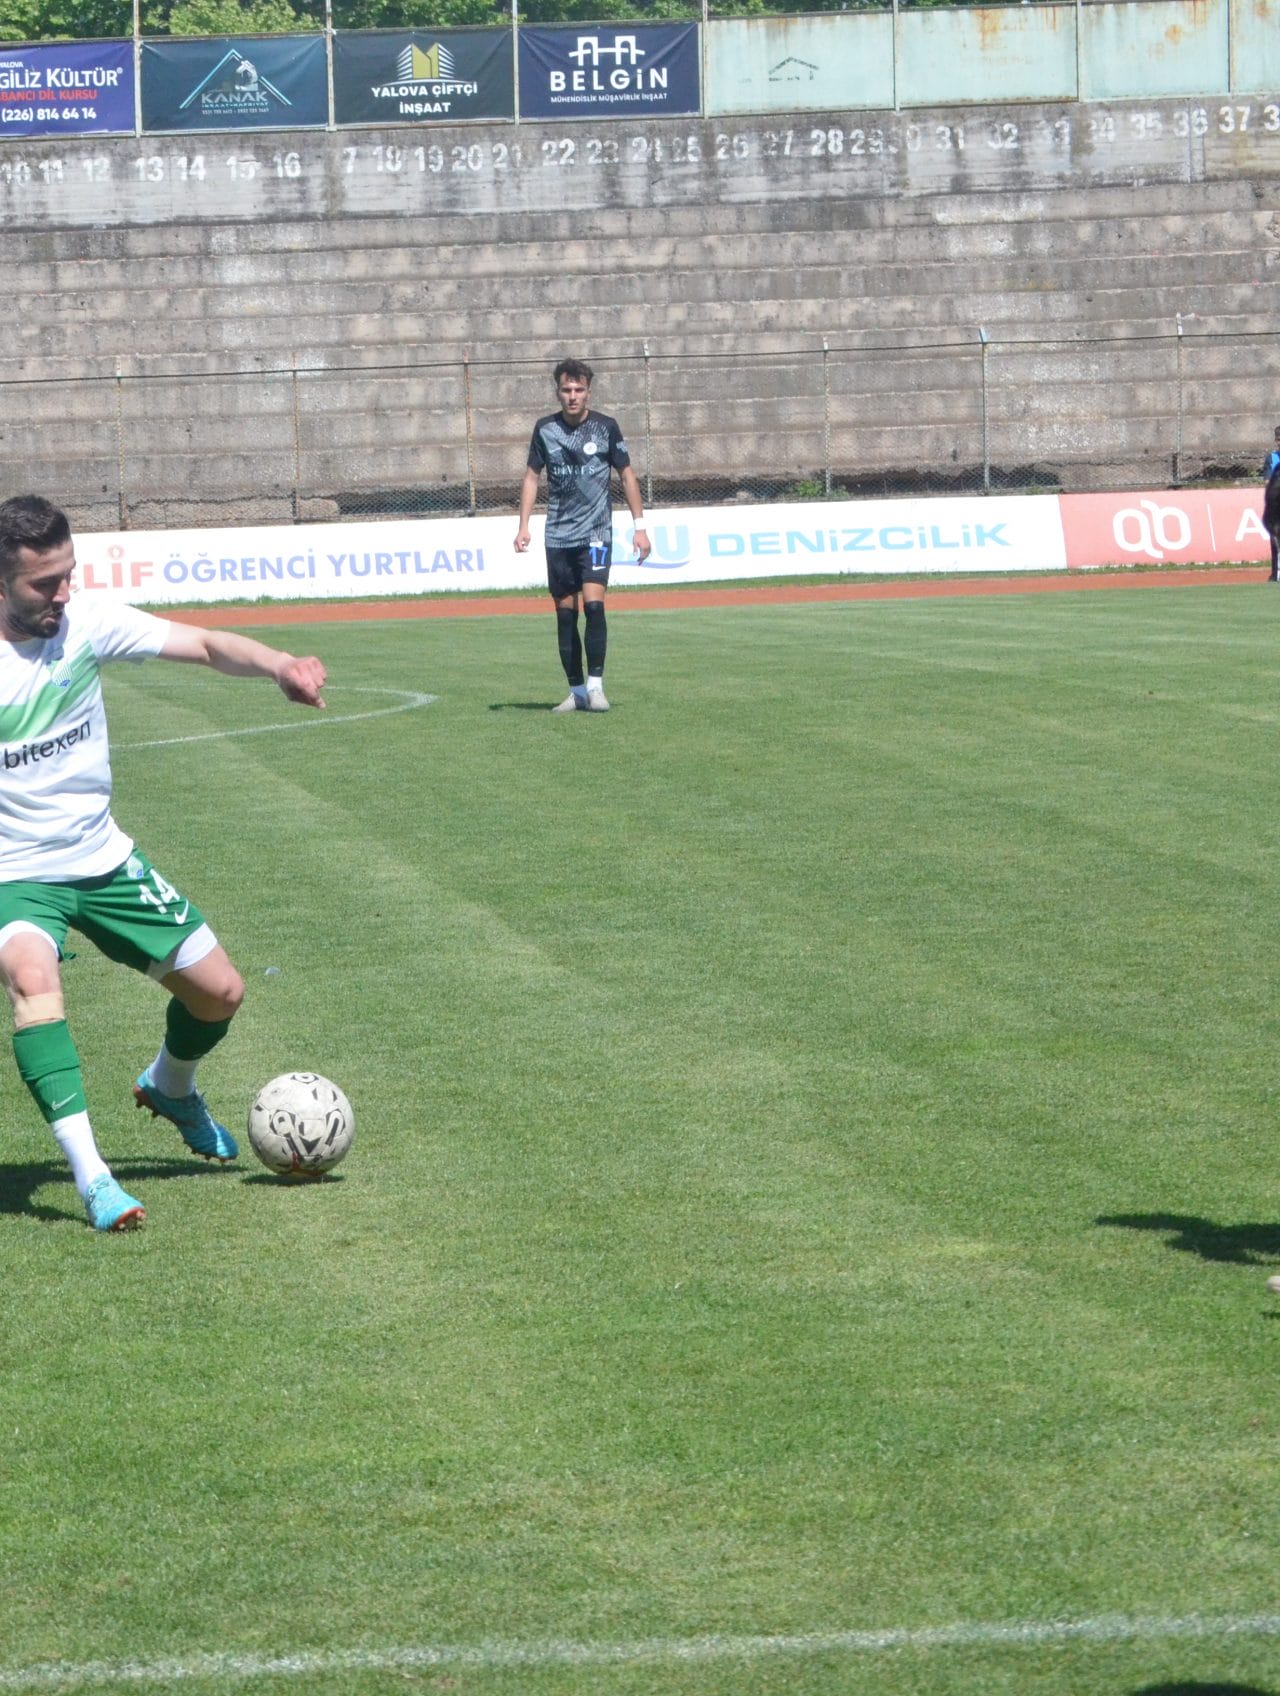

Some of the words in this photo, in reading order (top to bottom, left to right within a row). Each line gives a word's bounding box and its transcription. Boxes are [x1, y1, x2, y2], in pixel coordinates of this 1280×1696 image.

[0, 61, 24, 69] YALOVA
[38, 89, 56, 101] DİL
[60, 89, 98, 101] KURSU
[201, 91, 268, 104] KANAK
[371, 86, 429, 98] YALOVA
[431, 81, 478, 98] ÇİFTÇİ
[550, 94, 598, 103] MÜHENDİSLİK
[641, 92, 668, 101] İNŞAAT
[1, 107, 34, 123] (226)
[37, 108, 60, 120] 814
[62, 108, 80, 120] 64
[82, 107, 97, 119] 14
[399, 102, 451, 116] İNŞAAT
[38, 159, 63, 185] 11
[82, 157, 112, 184] 12
[134, 156, 164, 182] 13
[176, 154, 207, 182] 14
[272, 152, 302, 179] 16
[372, 146, 402, 173] 18
[414, 145, 444, 173] 19
[451, 143, 483, 171] 20
[541, 138, 575, 167] 22
[715, 133, 750, 160] 26
[810, 129, 845, 156] 28
[935, 124, 965, 151] 31
[987, 122, 1018, 150] 32
[1131, 112, 1163, 139] 35
[1173, 108, 1208, 137] 36
[1220, 105, 1251, 133] 37
[590, 546, 607, 565] 17
[163, 547, 317, 585] ÖĞRENCİ
[326, 548, 486, 578] YURTLARI
[4, 720, 91, 770] bitexen
[139, 868, 180, 914] 14
